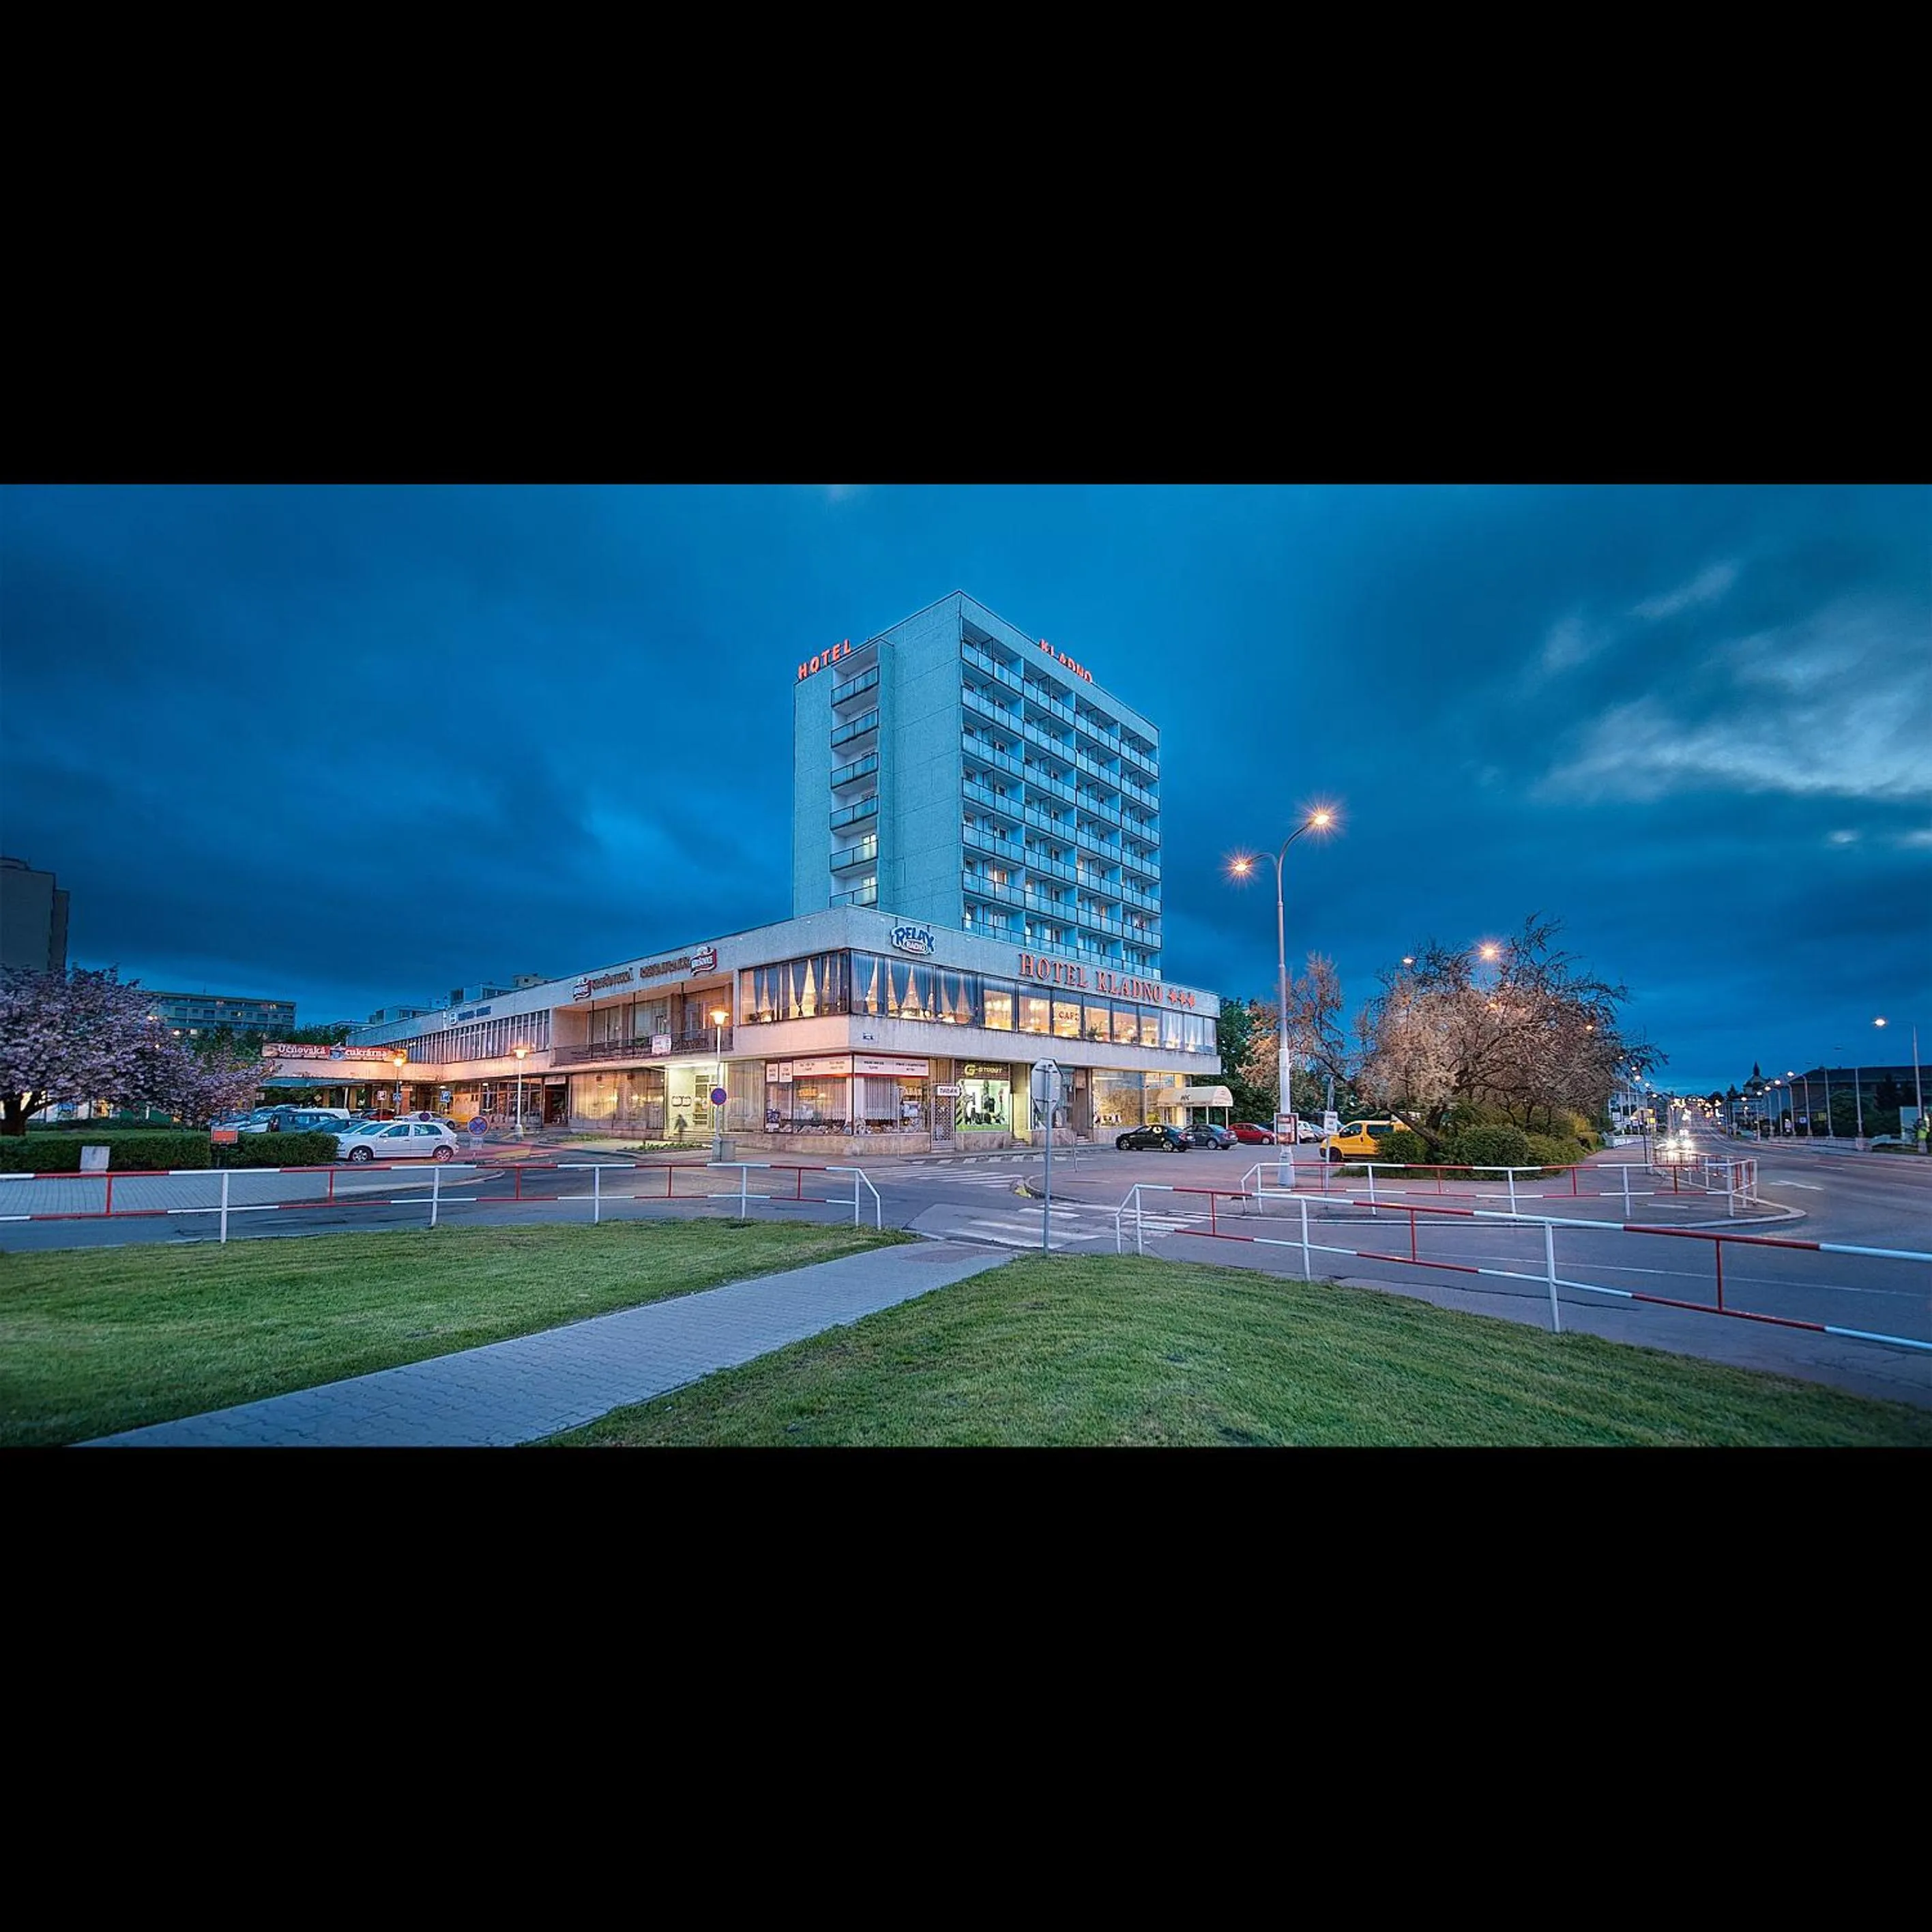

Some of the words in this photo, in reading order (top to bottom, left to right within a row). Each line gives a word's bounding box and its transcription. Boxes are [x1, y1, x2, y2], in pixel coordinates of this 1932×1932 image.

[797, 639, 852, 681] HOTEL
[1039, 639, 1093, 683] KLADNO
[894, 927, 935, 952] RELAX
[1018, 953, 1089, 988] HOTEL
[1096, 970, 1164, 1002] KLADNO
